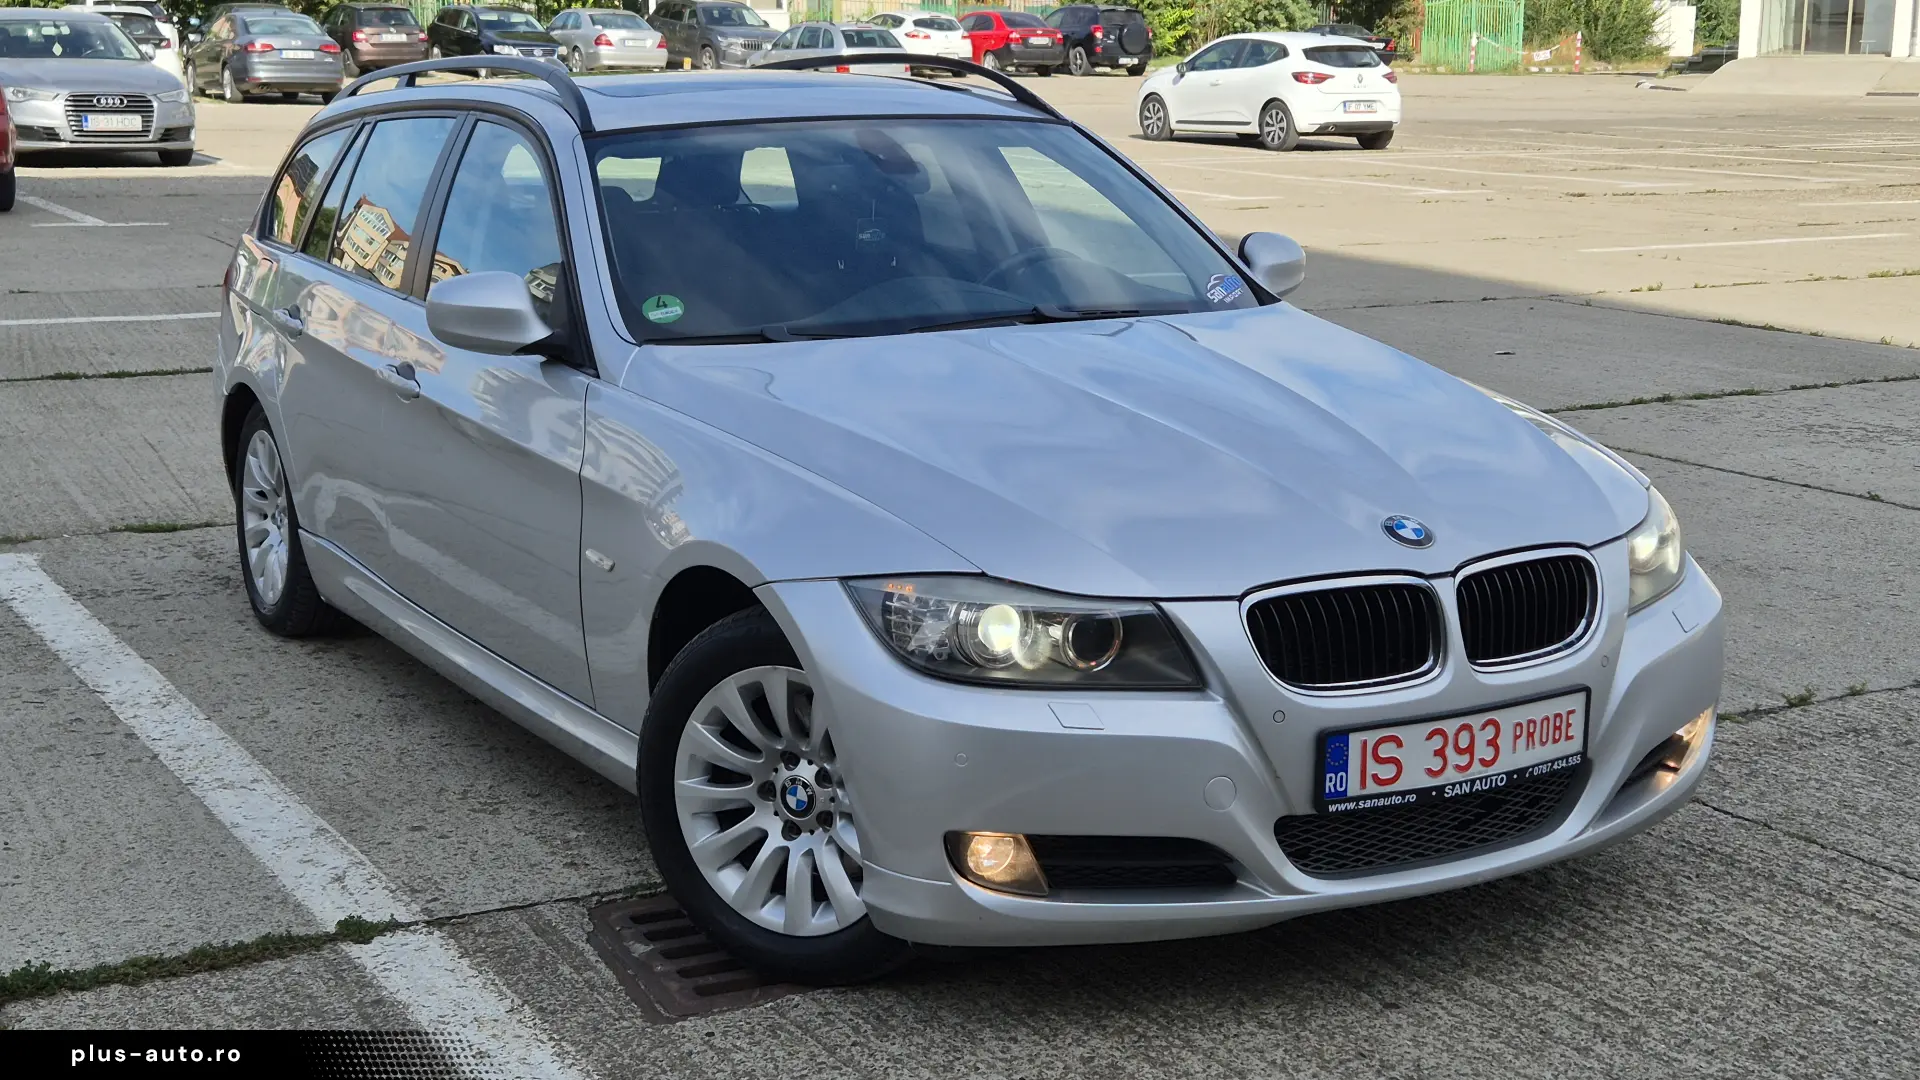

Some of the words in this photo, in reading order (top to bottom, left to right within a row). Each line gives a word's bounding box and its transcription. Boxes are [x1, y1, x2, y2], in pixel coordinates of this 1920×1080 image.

[656, 296, 668, 309] 4
[1360, 734, 1404, 791] IS
[1424, 717, 1501, 779] 393
[1512, 708, 1577, 755] PROBE
[1325, 771, 1347, 794] RO
[1328, 793, 1417, 813] www.sanauto.ro
[1444, 781, 1471, 798] SAN
[1472, 774, 1507, 793] AUTO
